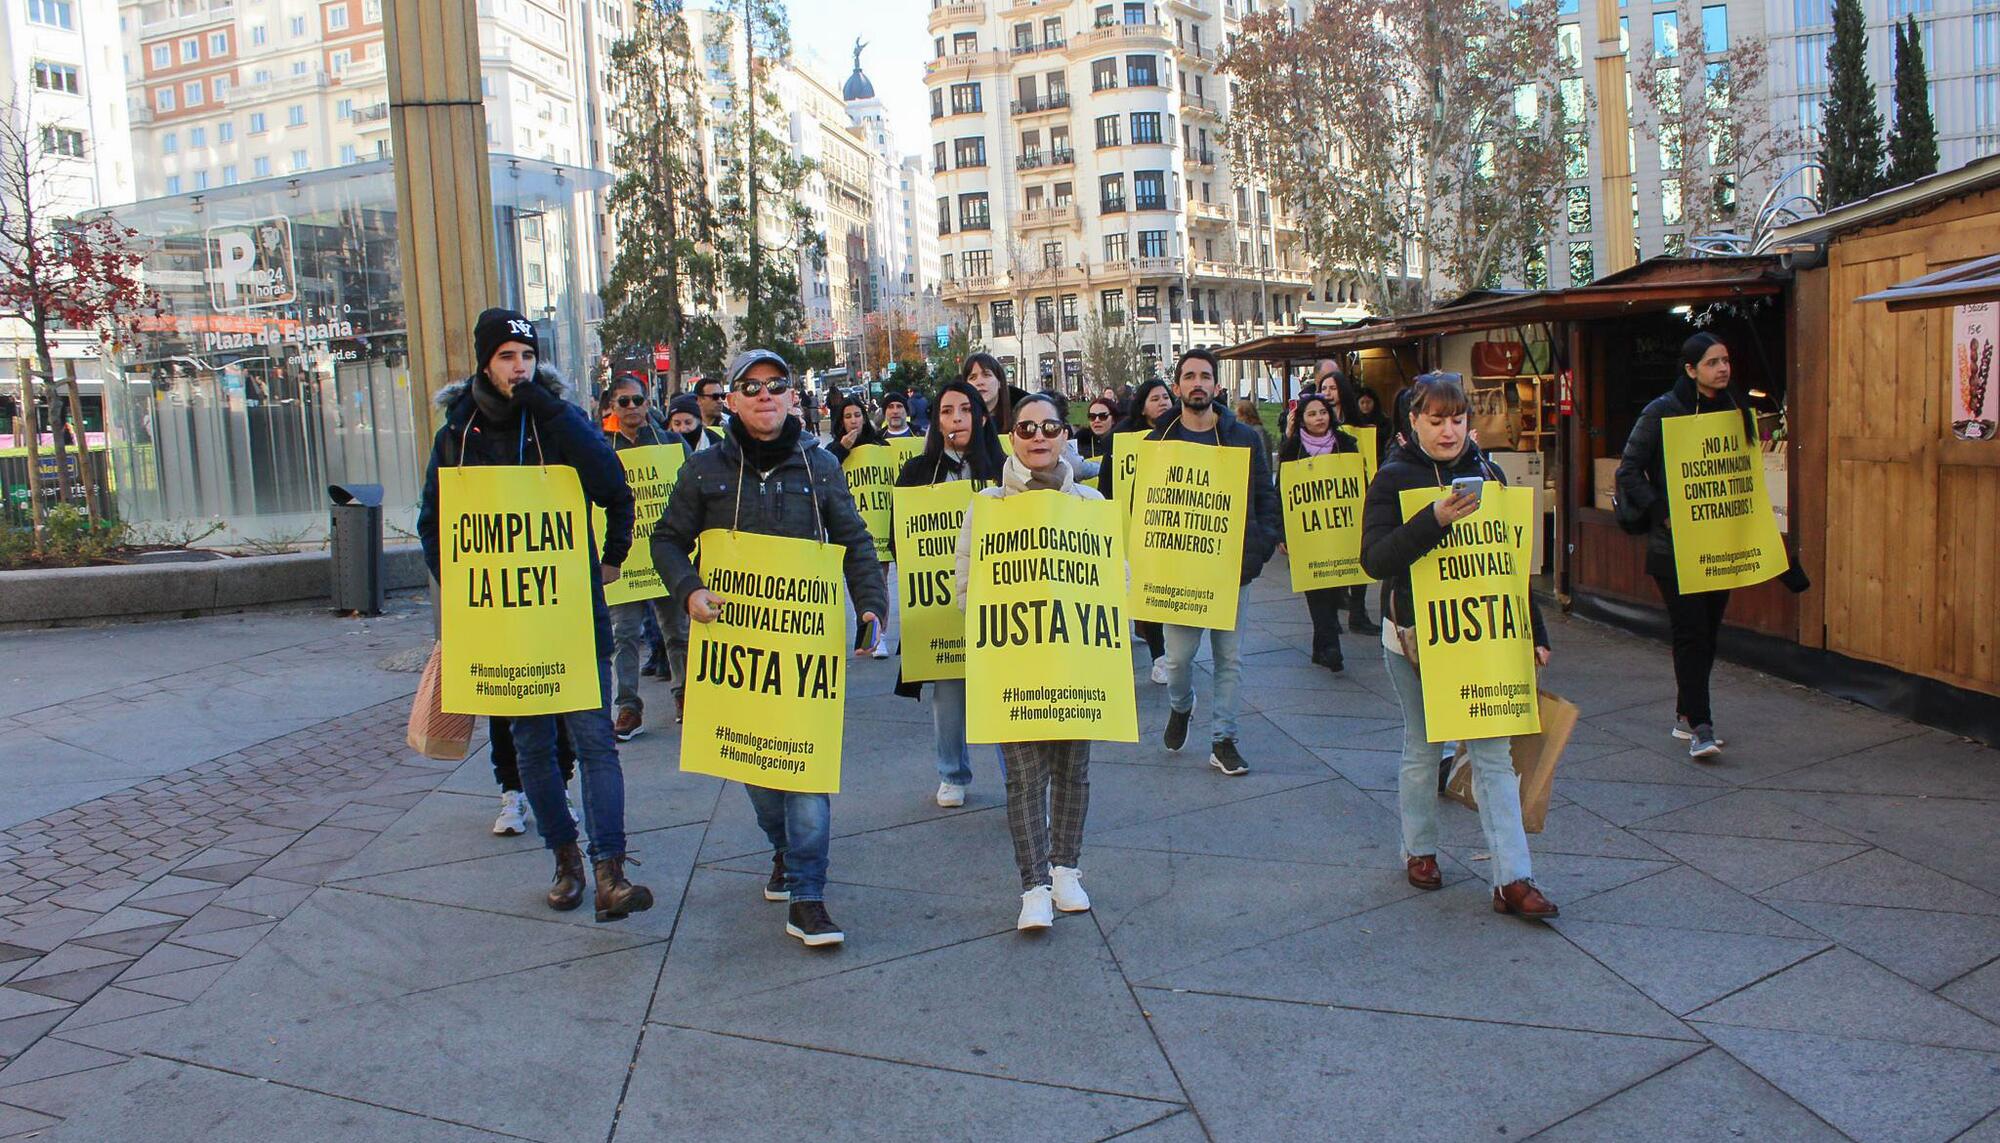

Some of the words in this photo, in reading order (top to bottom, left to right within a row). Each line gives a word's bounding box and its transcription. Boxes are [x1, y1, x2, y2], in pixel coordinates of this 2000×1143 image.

[220, 232, 256, 300] P
[255, 283, 286, 297] horas
[205, 331, 253, 351] Plaza
[256, 326, 281, 346] de
[284, 317, 352, 346] España
[508, 320, 533, 337] NY
[1702, 437, 1720, 458] ¡NO
[1723, 437, 1731, 452] A
[1731, 435, 1739, 452] LA
[638, 468, 645, 482] A
[646, 466, 659, 481] LA
[1165, 465, 1183, 486] ¡NO
[1186, 467, 1193, 484] A
[1197, 468, 1209, 487] LA
[1147, 487, 1231, 512] DISCRIMINACIÓN
[1288, 477, 1359, 512] ¡CUMPLAN
[1684, 480, 1727, 500] CONTRA
[1727, 475, 1754, 495] TÍTULOS
[1144, 509, 1180, 528] CONTRA
[1184, 509, 1229, 534] TÍTULOS
[1302, 510, 1321, 533] LA
[1325, 506, 1354, 529] LEY!
[1691, 498, 1749, 521] EXTRANJEROS
[453, 511, 574, 562] ¡CUMPLAN
[979, 527, 1100, 561] ¡HOMOLOGACIÓN
[1103, 536, 1113, 558] Y
[1145, 531, 1214, 555] EXTRANJEROS
[1514, 526, 1523, 548] Y
[992, 557, 1099, 586] EQUIVALENCIA
[469, 567, 493, 608] LA
[501, 565, 558, 608] LEY!
[708, 567, 828, 605] ¡HOMOLOGACIÓN
[830, 582, 837, 605] Y
[716, 601, 825, 636] EQUIVALENCIA
[976, 599, 1069, 649] JUSTA
[1075, 602, 1121, 649] YA!
[1428, 593, 1516, 646] JUSTA
[470, 661, 566, 681] #Homologacionjusta
[697, 639, 782, 696] JUSTA
[796, 653, 839, 700] YA!
[476, 680, 561, 699] #Homologacionya
[1002, 685, 1106, 703] #Homologacionjusta
[1010, 703, 1102, 722] #Homologacionya
[715, 725, 814, 754] #Homologacionjusta
[720, 744, 805, 772] #Homologacionya
